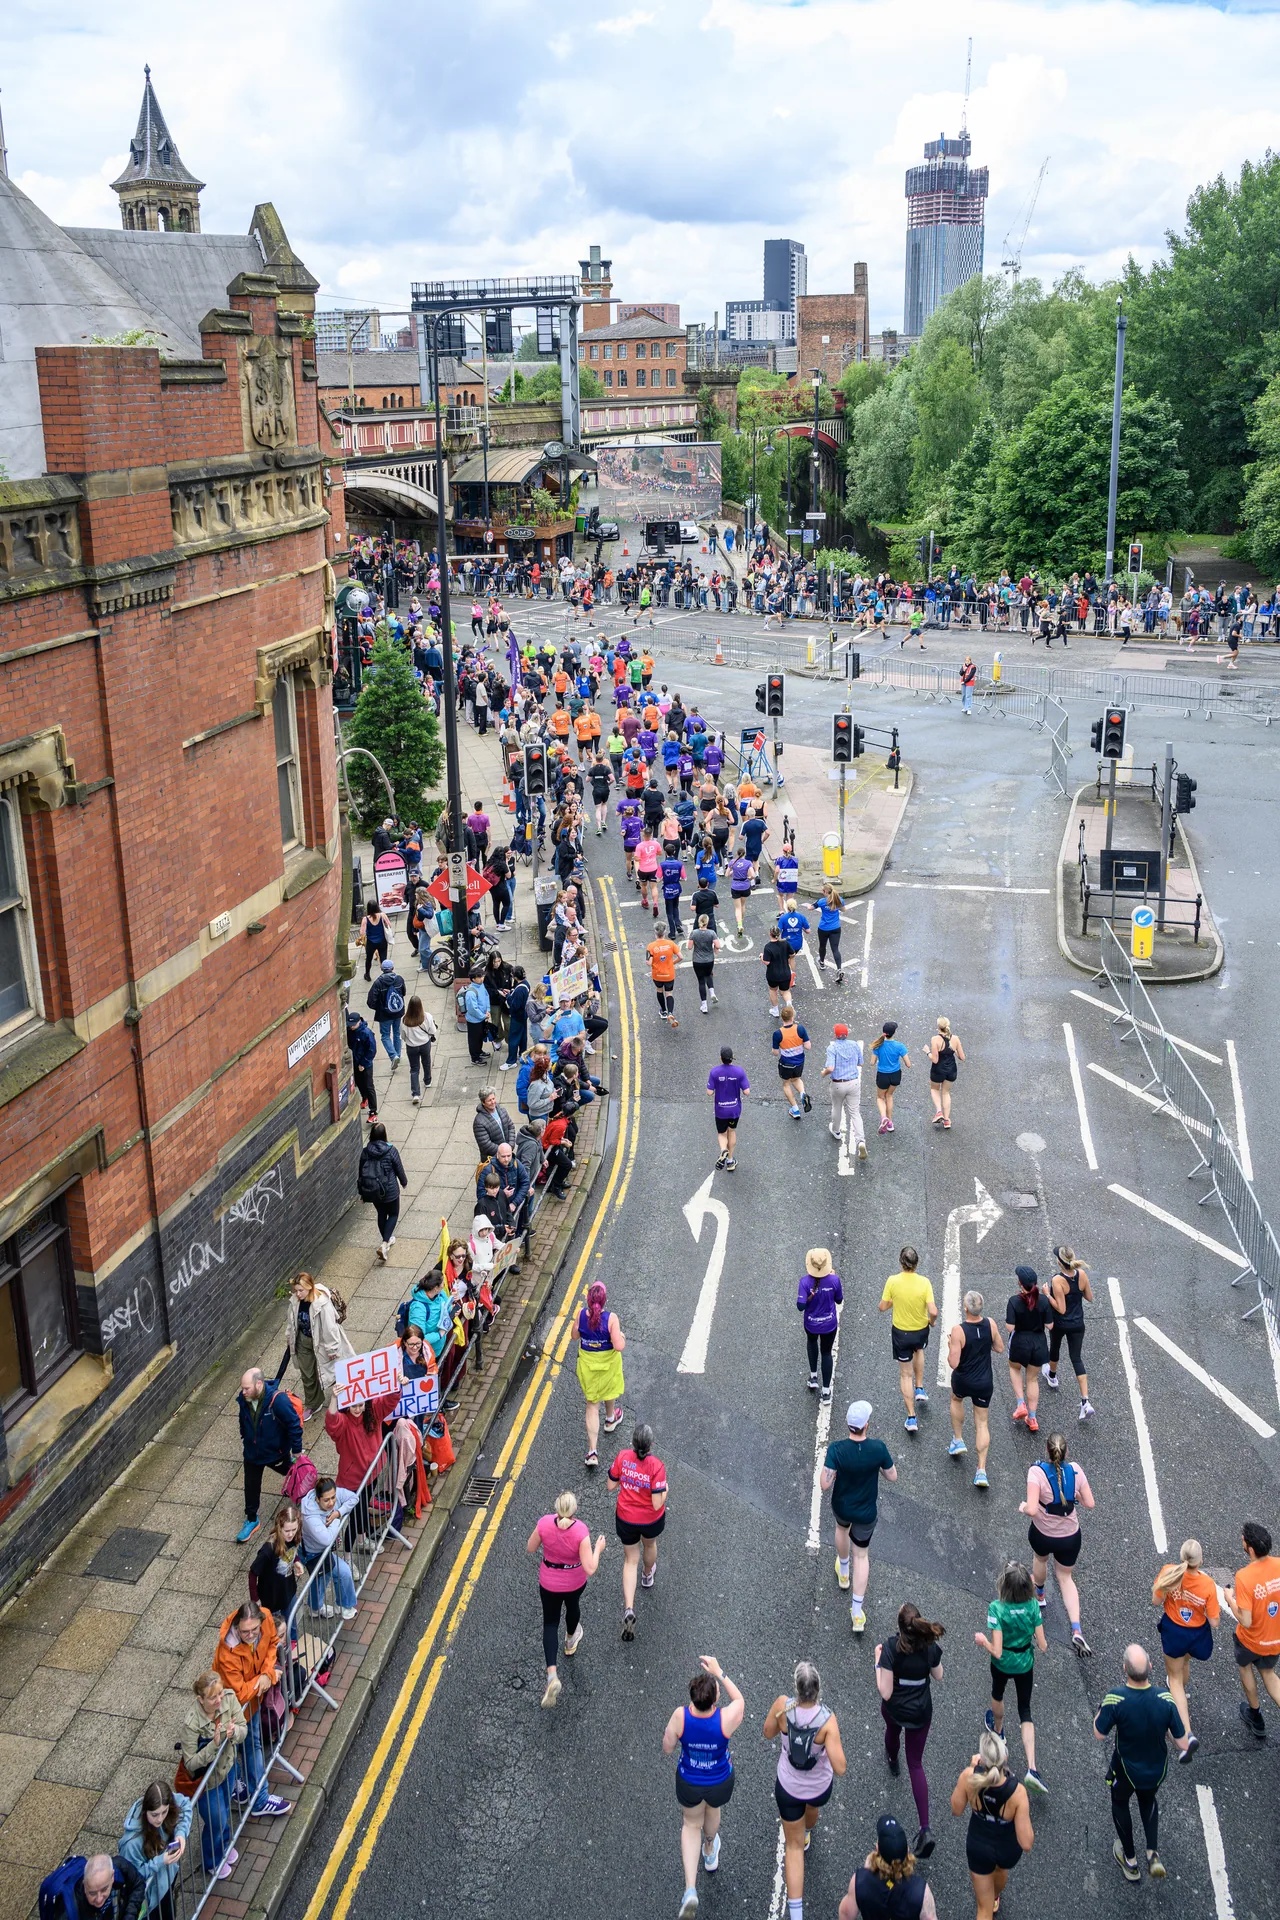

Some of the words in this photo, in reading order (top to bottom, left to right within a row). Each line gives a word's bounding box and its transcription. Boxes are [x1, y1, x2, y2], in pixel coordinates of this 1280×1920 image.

[465, 880, 480, 890] ell
[288, 1019, 323, 1055] WHITWORTH
[323, 1013, 330, 1025] ST
[303, 1033, 318, 1052] WEST
[346, 1351, 389, 1384] GO
[341, 1367, 398, 1406] JACS!
[622, 1459, 637, 1470] OUR
[635, 1480, 651, 1489] OUR
